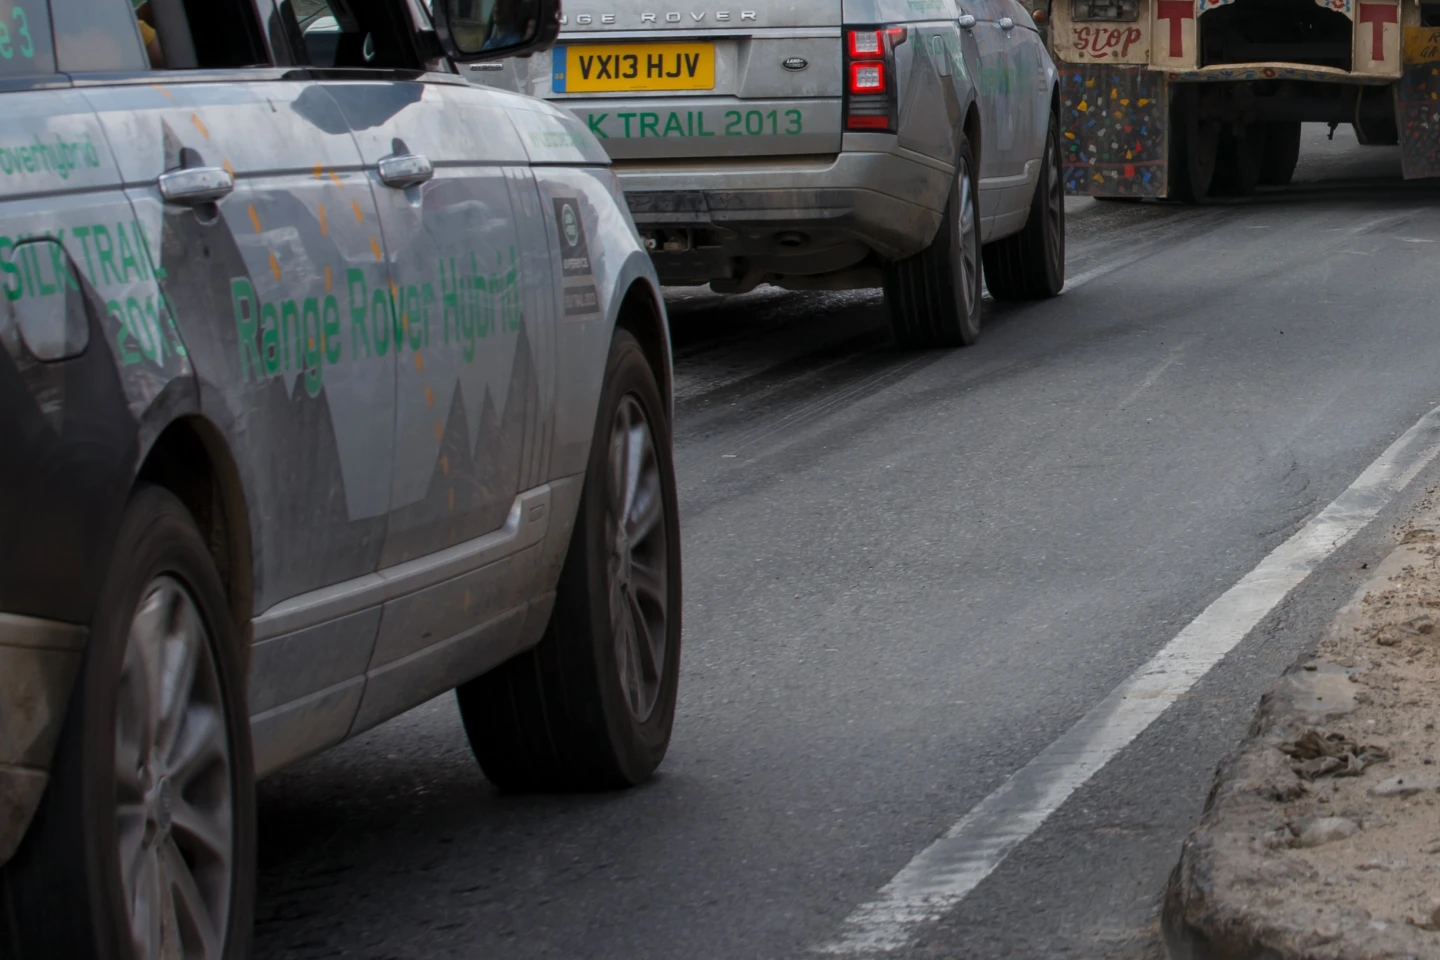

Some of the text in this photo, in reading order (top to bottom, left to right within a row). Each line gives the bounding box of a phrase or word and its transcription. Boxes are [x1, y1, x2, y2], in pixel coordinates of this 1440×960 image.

[641, 10, 757, 23] ROVER
[1157, 0, 1194, 58] T
[1360, 3, 1398, 61] T
[578, 52, 700, 80] VX13 HJV
[617, 110, 716, 139] TRAIL
[725, 108, 803, 137] 2013
[230, 278, 343, 398] Range
[346, 267, 436, 361] Rover
